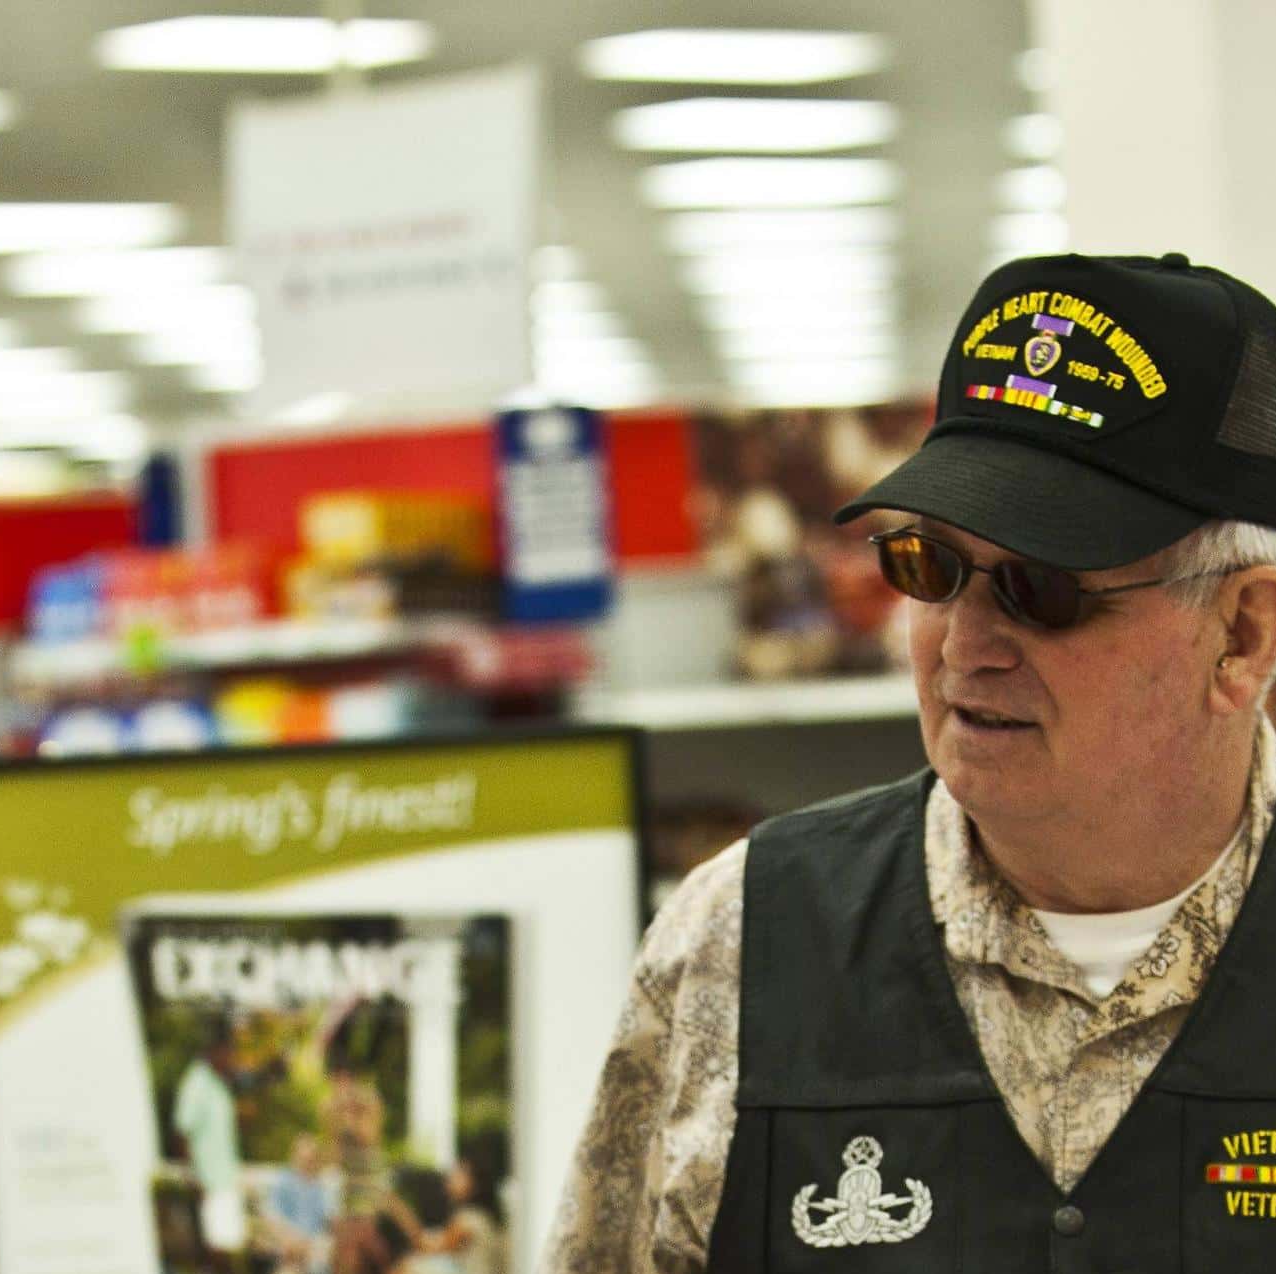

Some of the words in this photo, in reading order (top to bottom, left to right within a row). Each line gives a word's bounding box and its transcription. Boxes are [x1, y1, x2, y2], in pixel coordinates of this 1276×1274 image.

[1003, 291, 1049, 321] HEART
[1049, 291, 1115, 338] COMBAT
[1105, 326, 1167, 399] WOUNDED
[126, 783, 315, 855] Spring's
[315, 770, 477, 852] finest!
